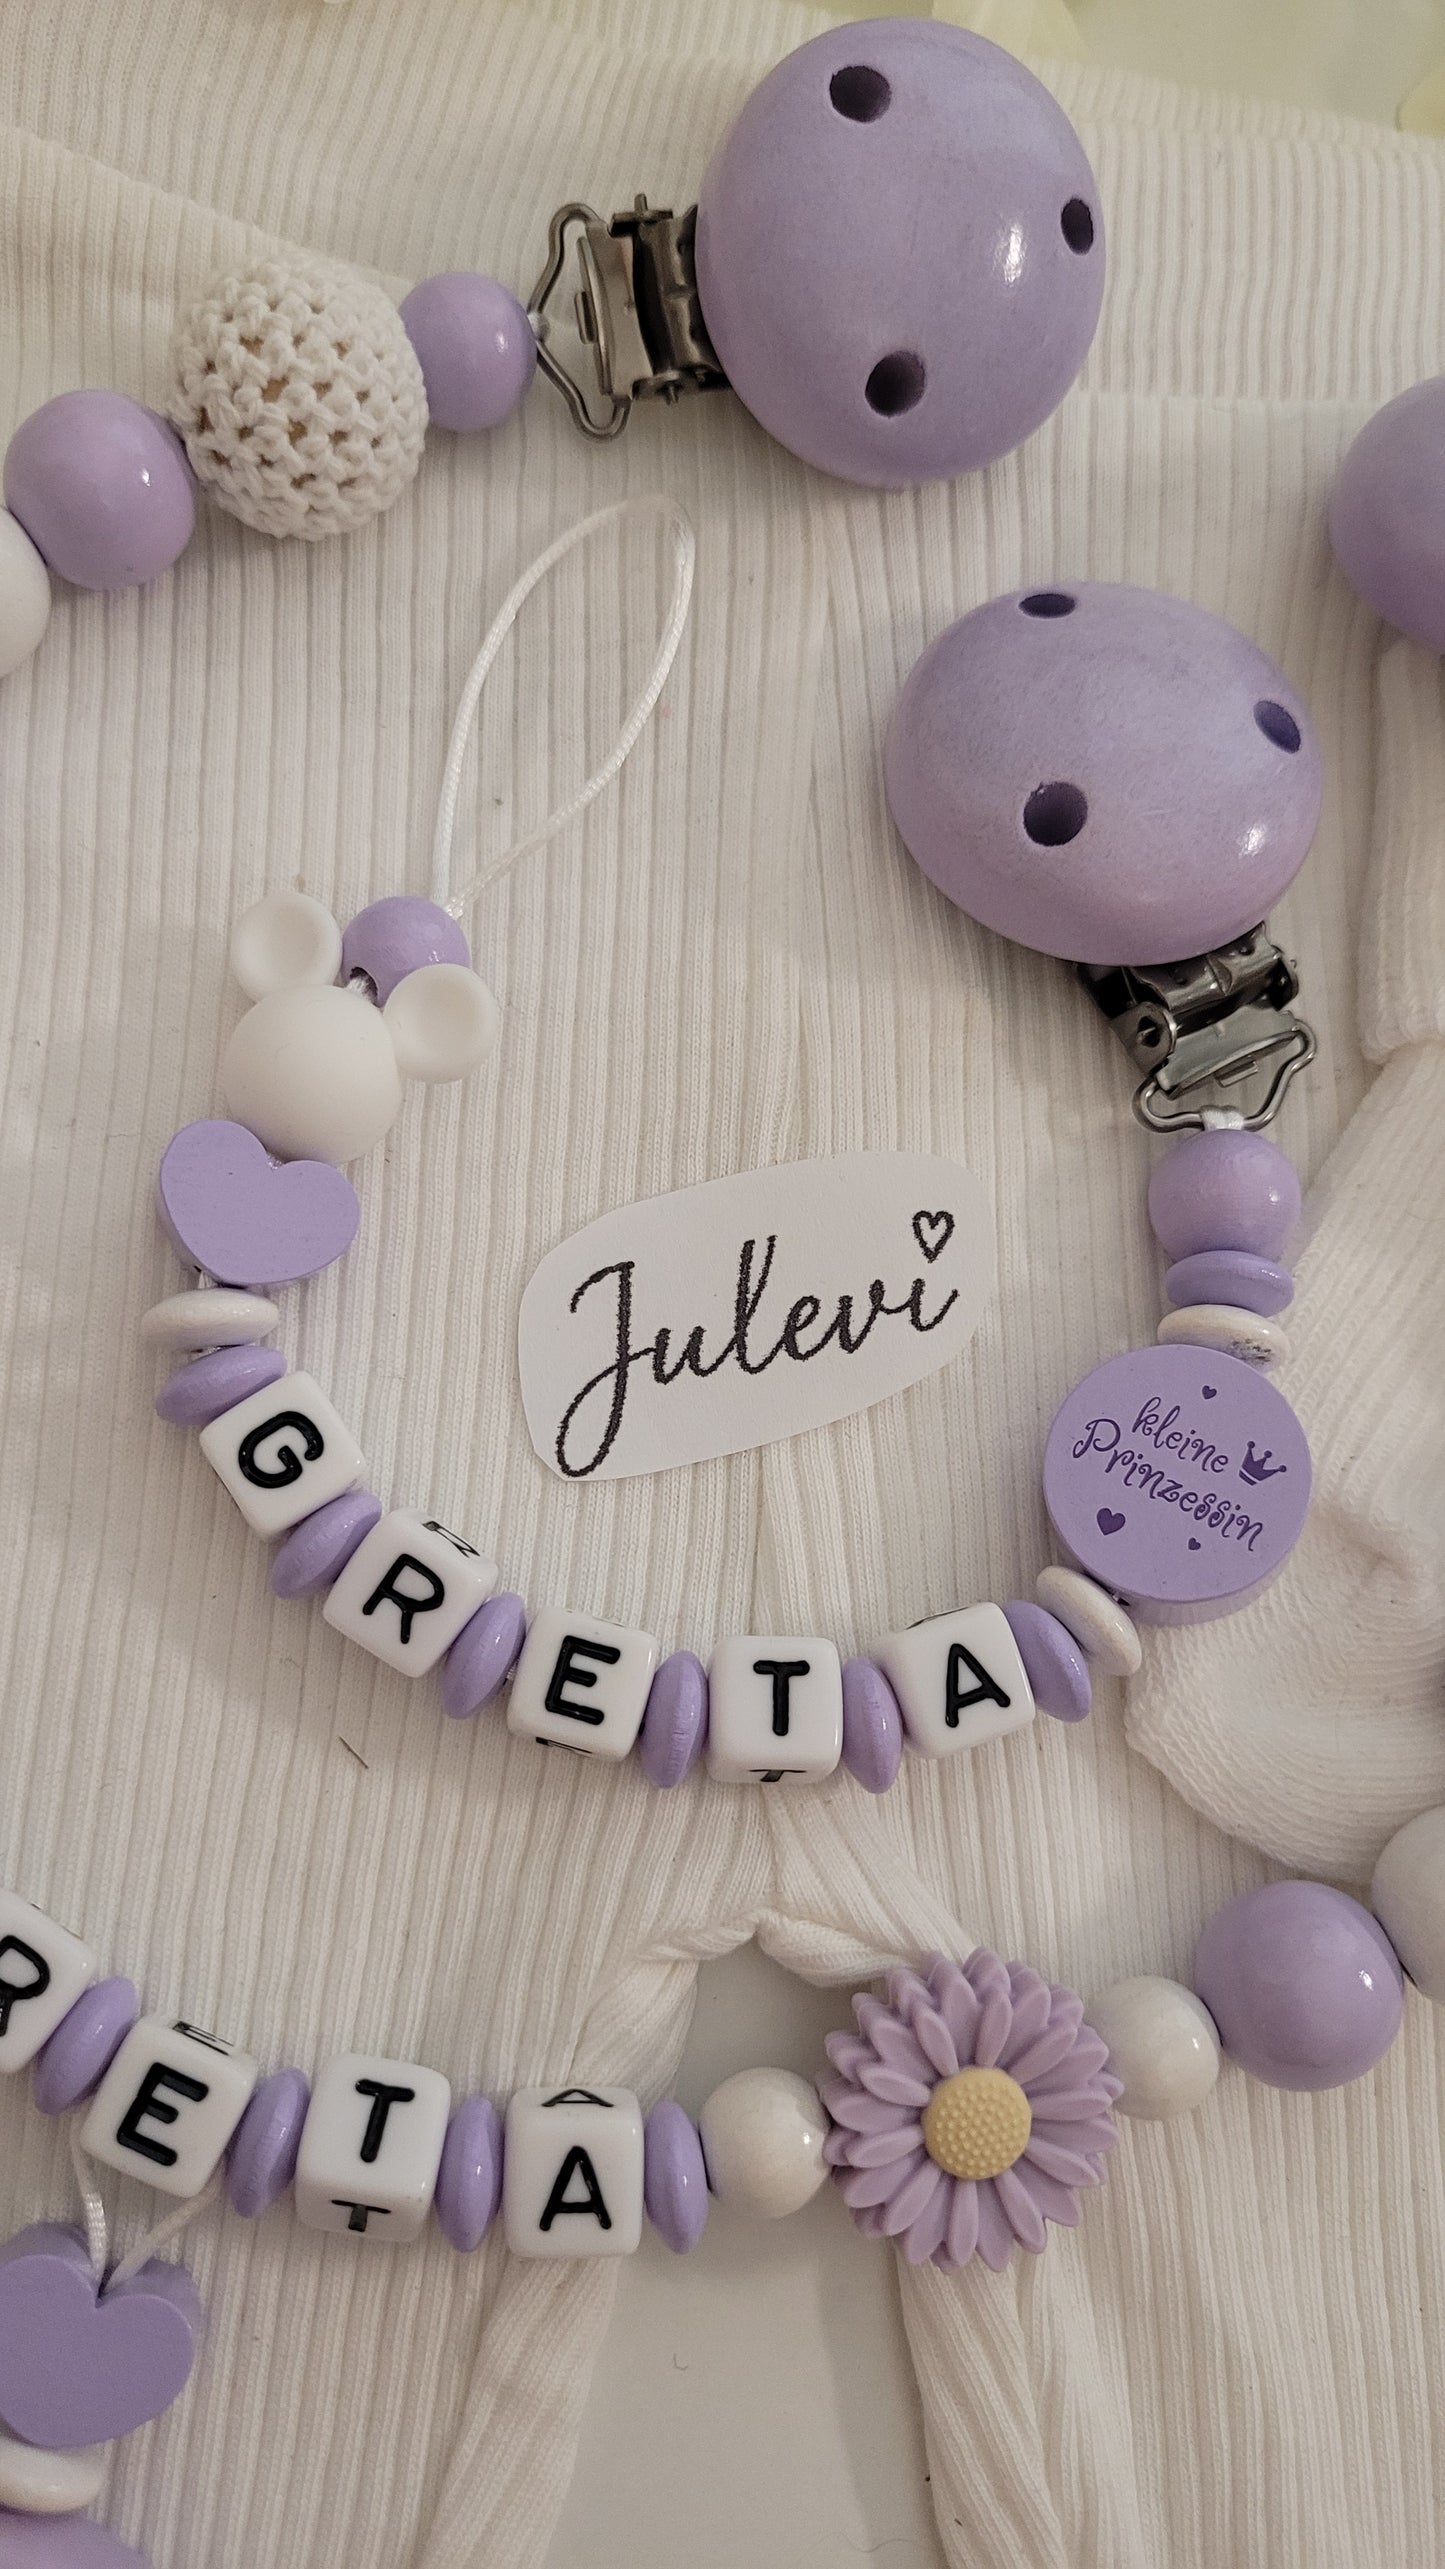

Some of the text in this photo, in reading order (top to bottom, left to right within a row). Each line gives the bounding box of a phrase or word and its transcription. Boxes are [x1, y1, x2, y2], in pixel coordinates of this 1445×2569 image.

[556, 1211, 959, 1477] Julevi
[1132, 1397, 1228, 1473] kleine
[238, 1410, 1010, 1736] GRETA
[1072, 1418, 1263, 1551] Prinzessin
